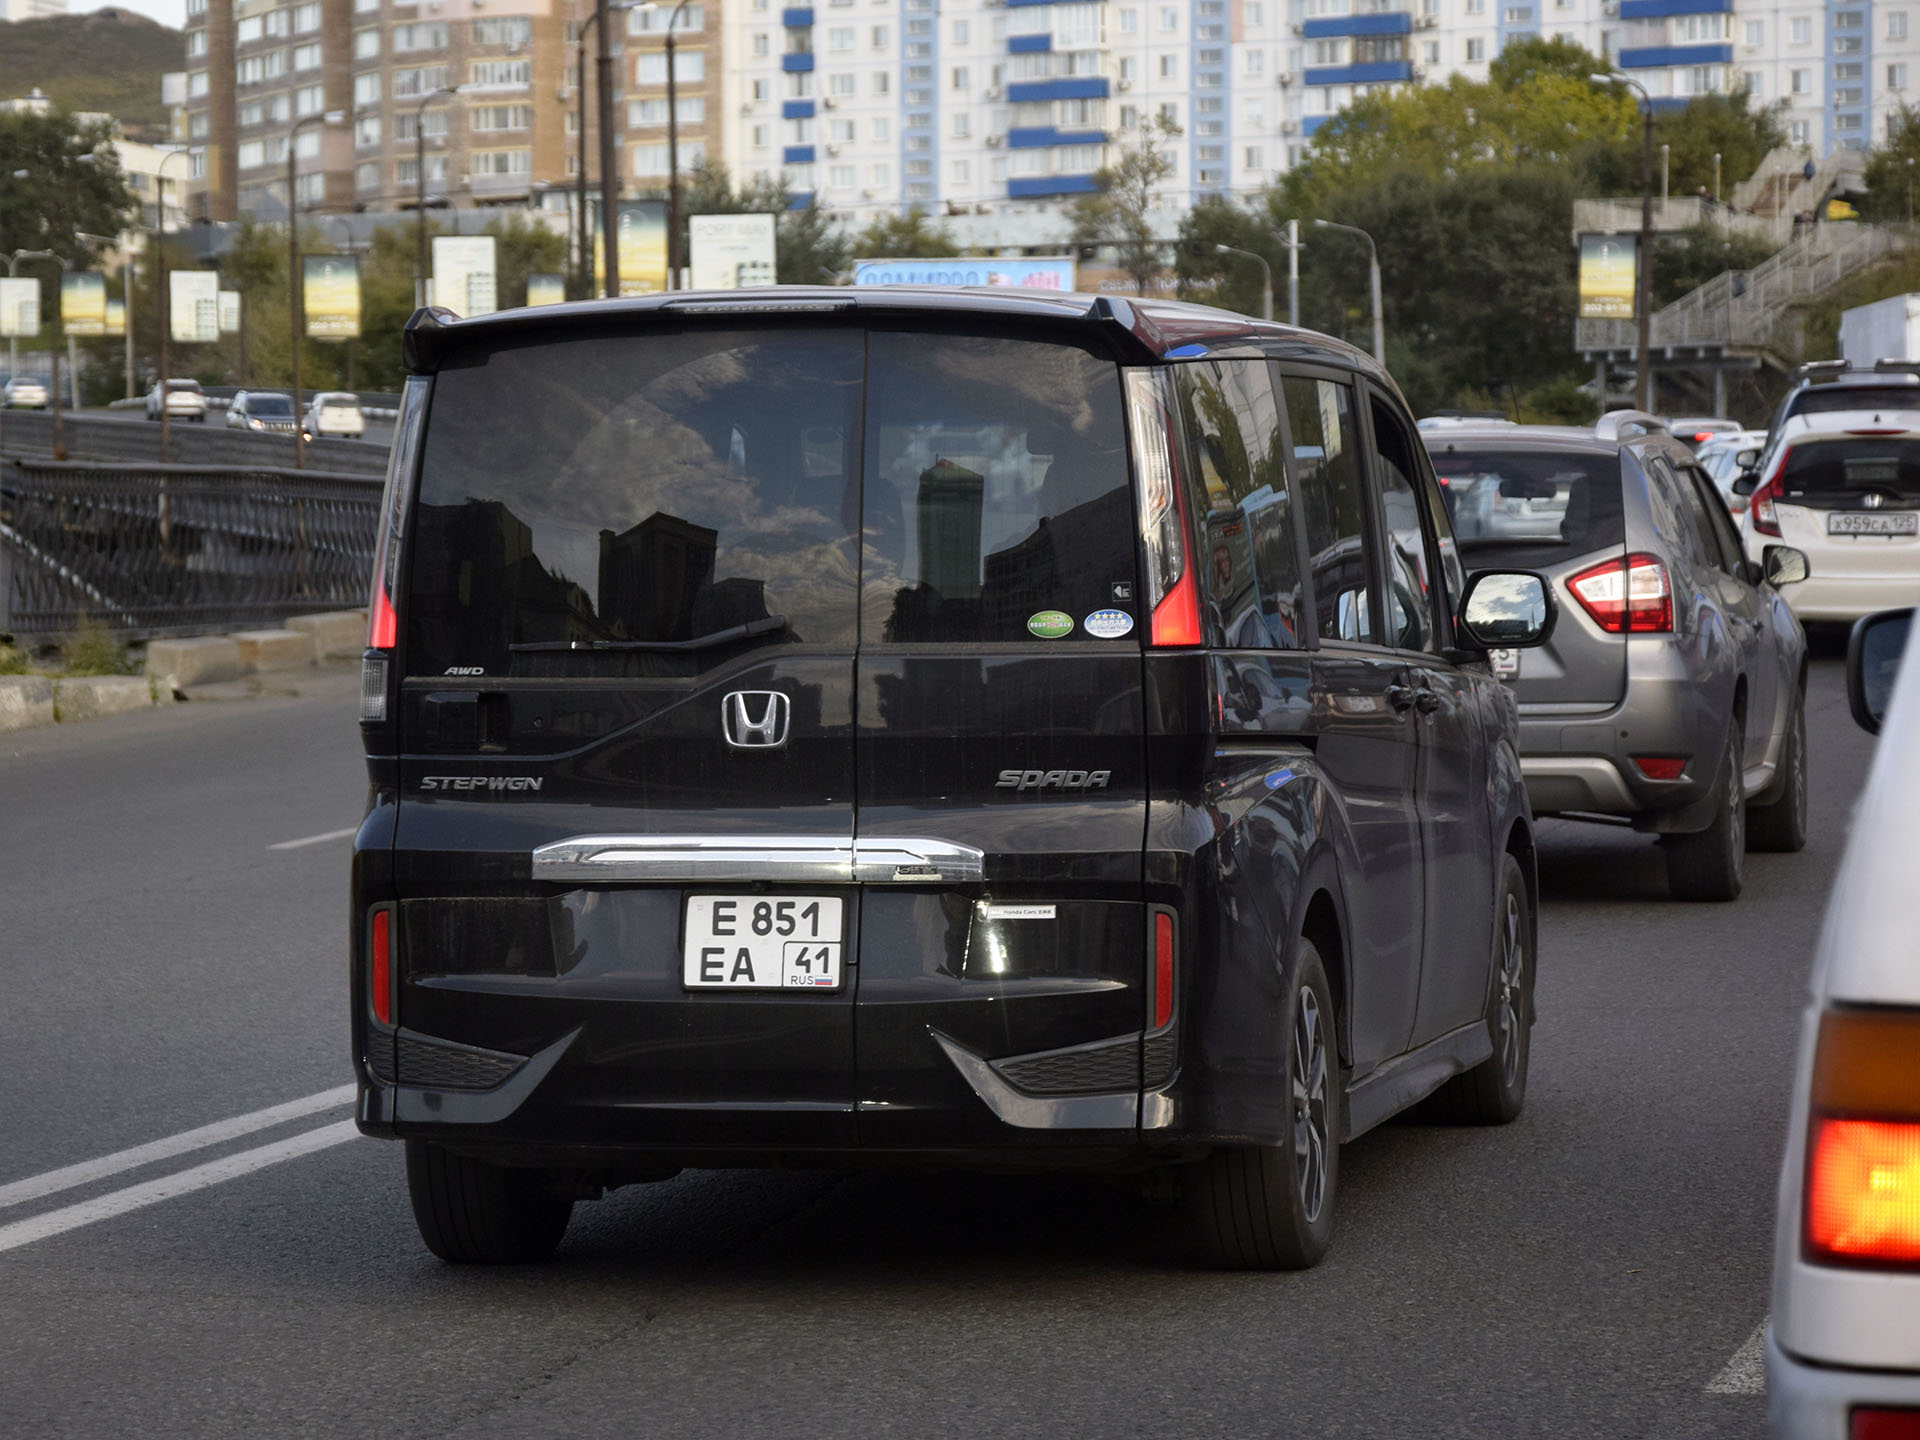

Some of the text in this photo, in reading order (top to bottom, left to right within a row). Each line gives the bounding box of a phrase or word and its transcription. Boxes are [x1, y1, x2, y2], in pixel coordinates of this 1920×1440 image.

[444, 666, 485, 675] AWD
[420, 776, 543, 790] STEPWGN
[995, 770, 1111, 790] SPADA
[712, 901, 819, 936] E 851
[700, 946, 830, 982] EA 41
[790, 975, 814, 985] RUS
